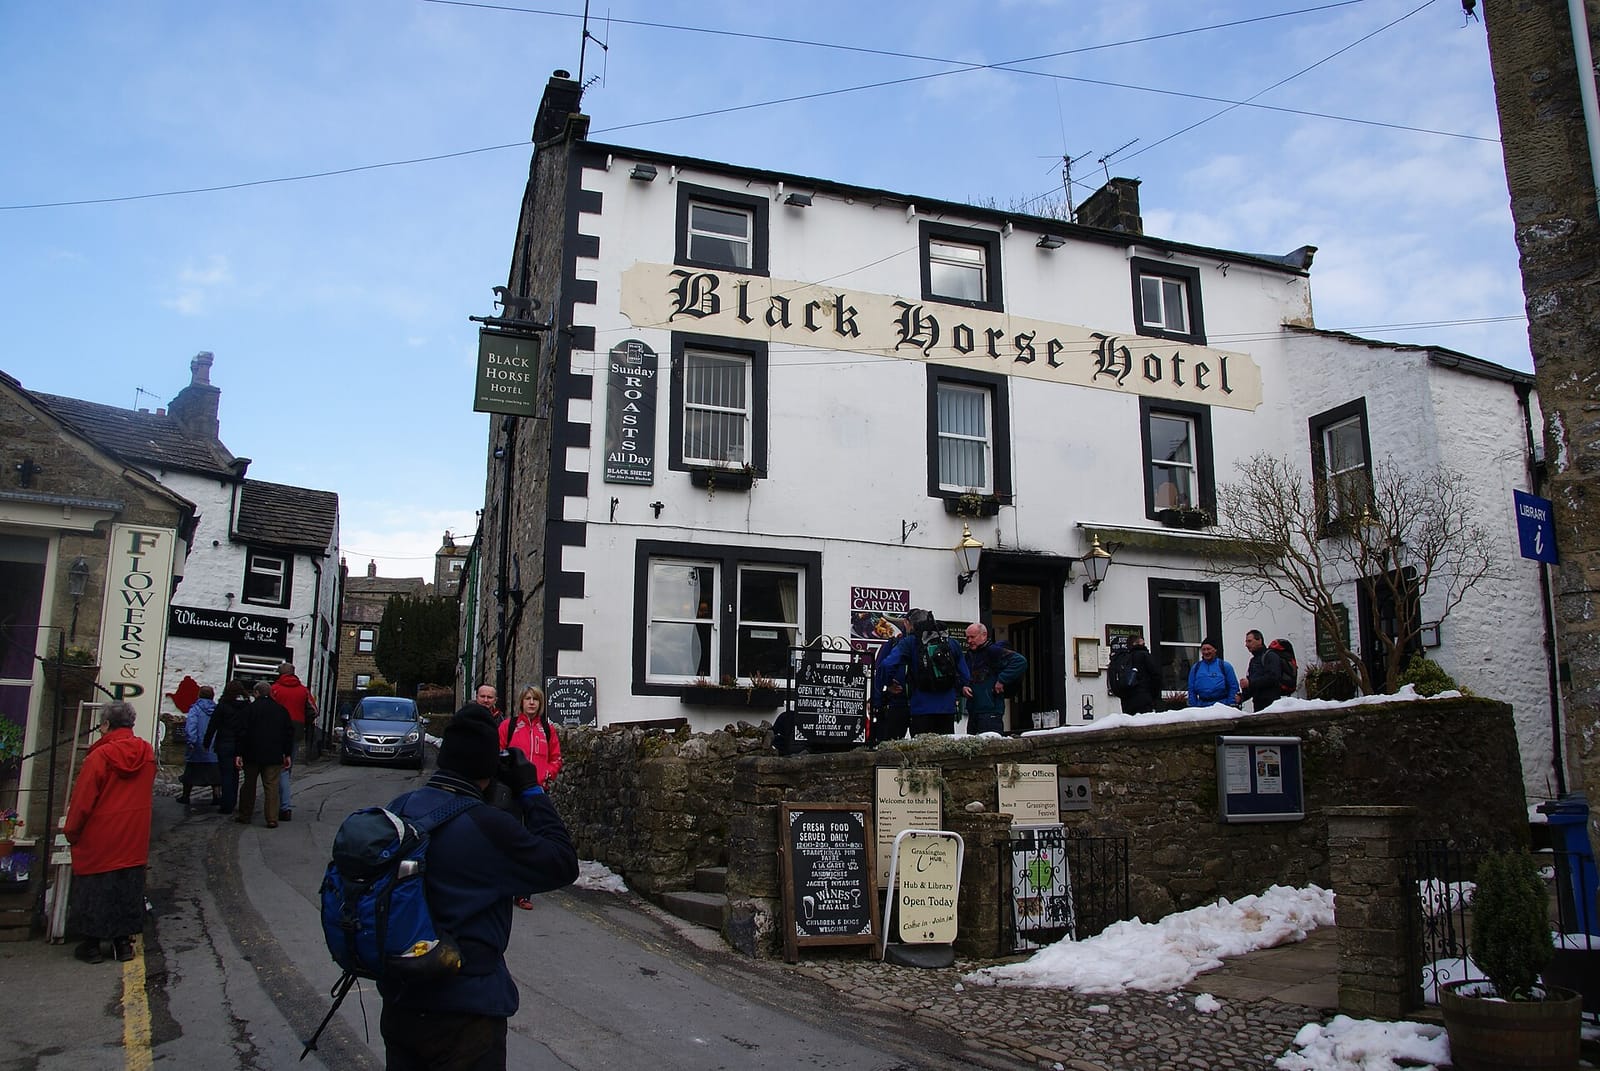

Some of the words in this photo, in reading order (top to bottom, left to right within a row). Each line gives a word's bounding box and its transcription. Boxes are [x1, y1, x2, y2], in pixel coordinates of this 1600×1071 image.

[669, 269, 861, 339] Black
[892, 300, 1064, 368] Horse
[1090, 332, 1234, 395] Hotel
[488, 353, 529, 368] BLACK
[486, 368, 530, 382] HORSE
[611, 364, 655, 378] Sunday
[621, 376, 642, 451] ROASTS
[608, 453, 625, 463] All
[629, 454, 652, 466] Day
[1520, 504, 1546, 521] LIBRARY
[119, 530, 160, 660] FLOWERS
[854, 588, 902, 600] SUNDAY
[854, 599, 907, 612] CARVERY
[174, 609, 235, 628] Whimsical
[238, 616, 279, 638] Cottage
[120, 663, 138, 679] &
[823, 675, 846, 684] GENTLE
[852, 676, 864, 685] JAZZ
[798, 686, 812, 695] OPEN
[814, 687, 826, 696] MIC
[838, 688, 864, 698] MONTHLY
[798, 699, 824, 708] KARAOKE
[832, 700, 864, 710] SATURDAYS
[818, 714, 836, 724] DISCO
[802, 823, 824, 832] FRESH
[830, 823, 849, 832] FOOD
[800, 832, 826, 841] SERVED
[830, 834, 848, 842] DAILY
[911, 848, 946, 857] Grassington
[904, 881, 918, 889] Hub
[928, 882, 953, 892] Library
[816, 888, 850, 900] WINES
[903, 896, 926, 908] Open
[928, 896, 954, 908] Today
[904, 920, 920, 930] Come
[932, 916, 946, 925] Join
